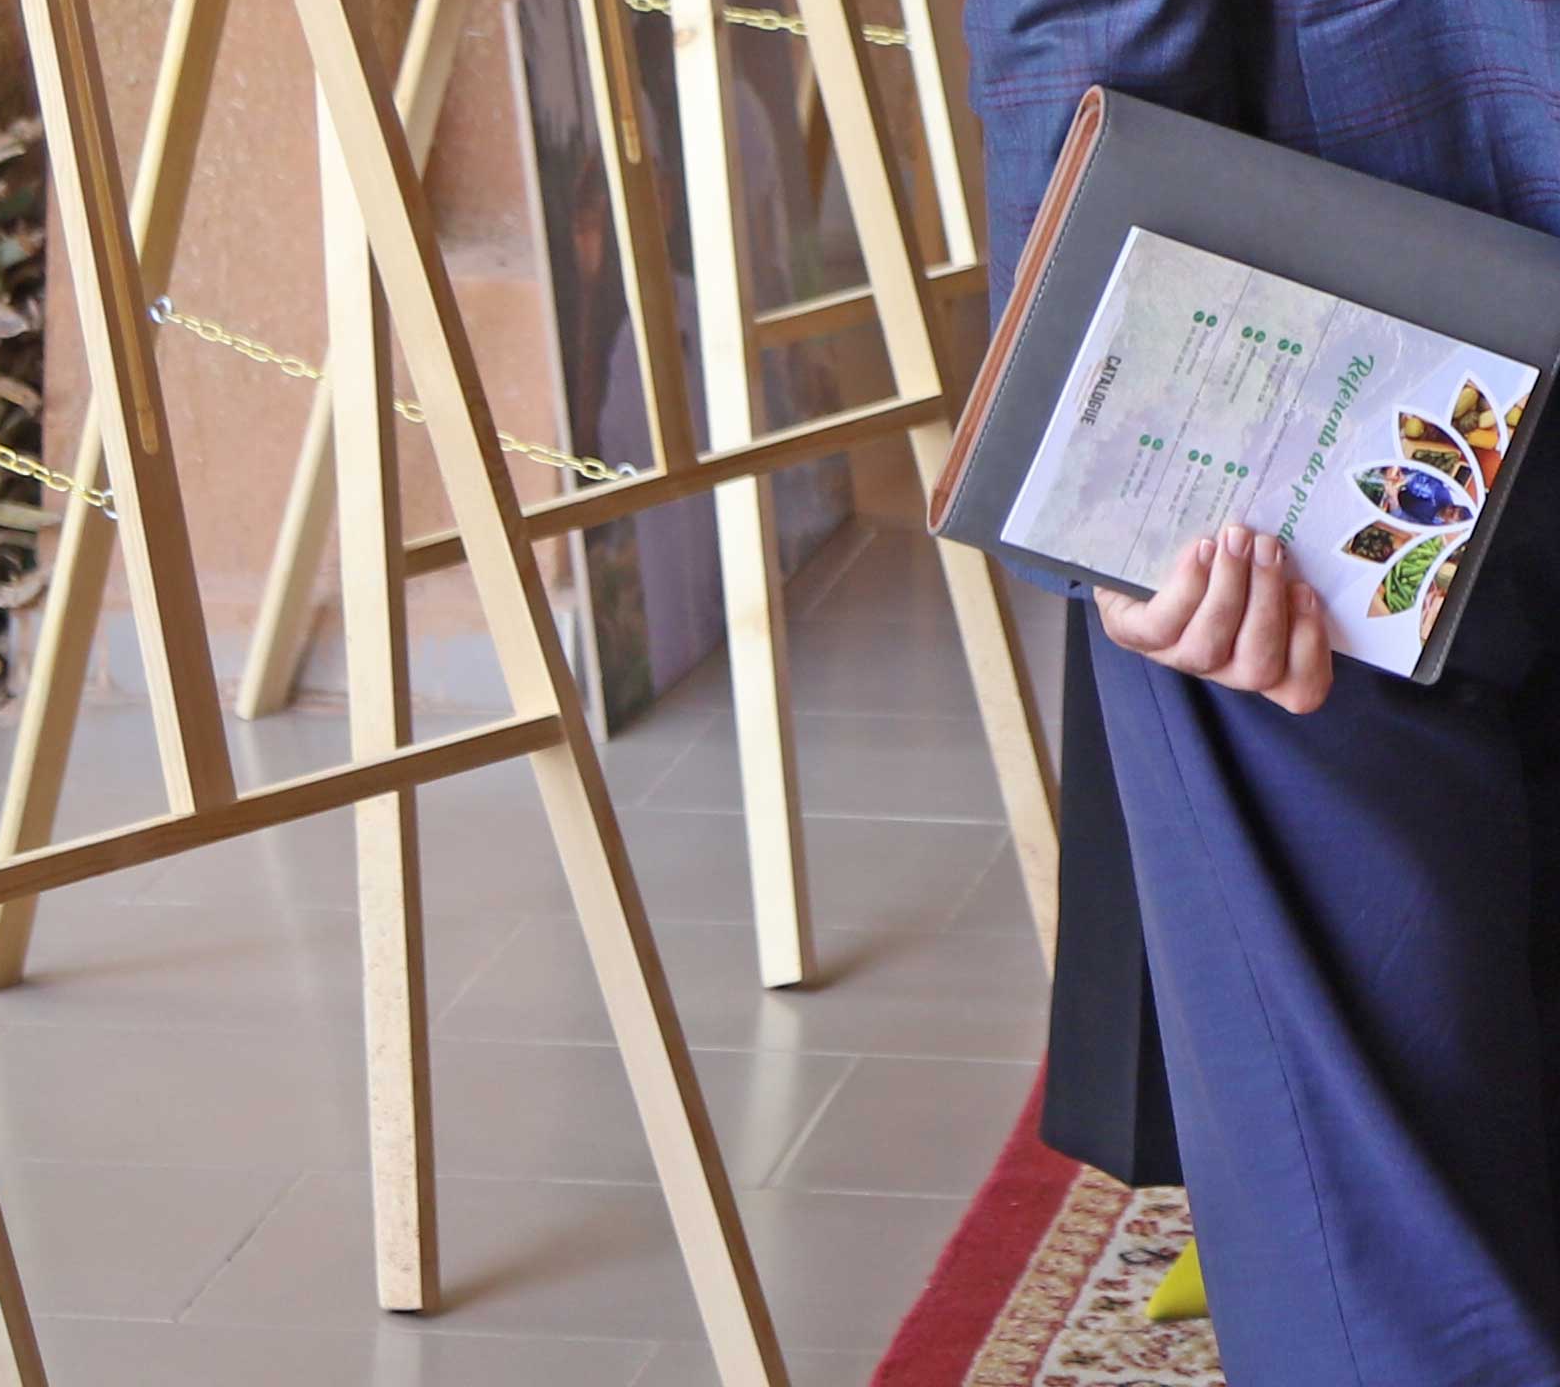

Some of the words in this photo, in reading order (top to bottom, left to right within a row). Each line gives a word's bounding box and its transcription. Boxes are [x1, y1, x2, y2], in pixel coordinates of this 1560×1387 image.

[1081, 355, 1122, 426] CATALOGUE
[1318, 355, 1374, 447] Référents
[1302, 452, 1325, 485] des
